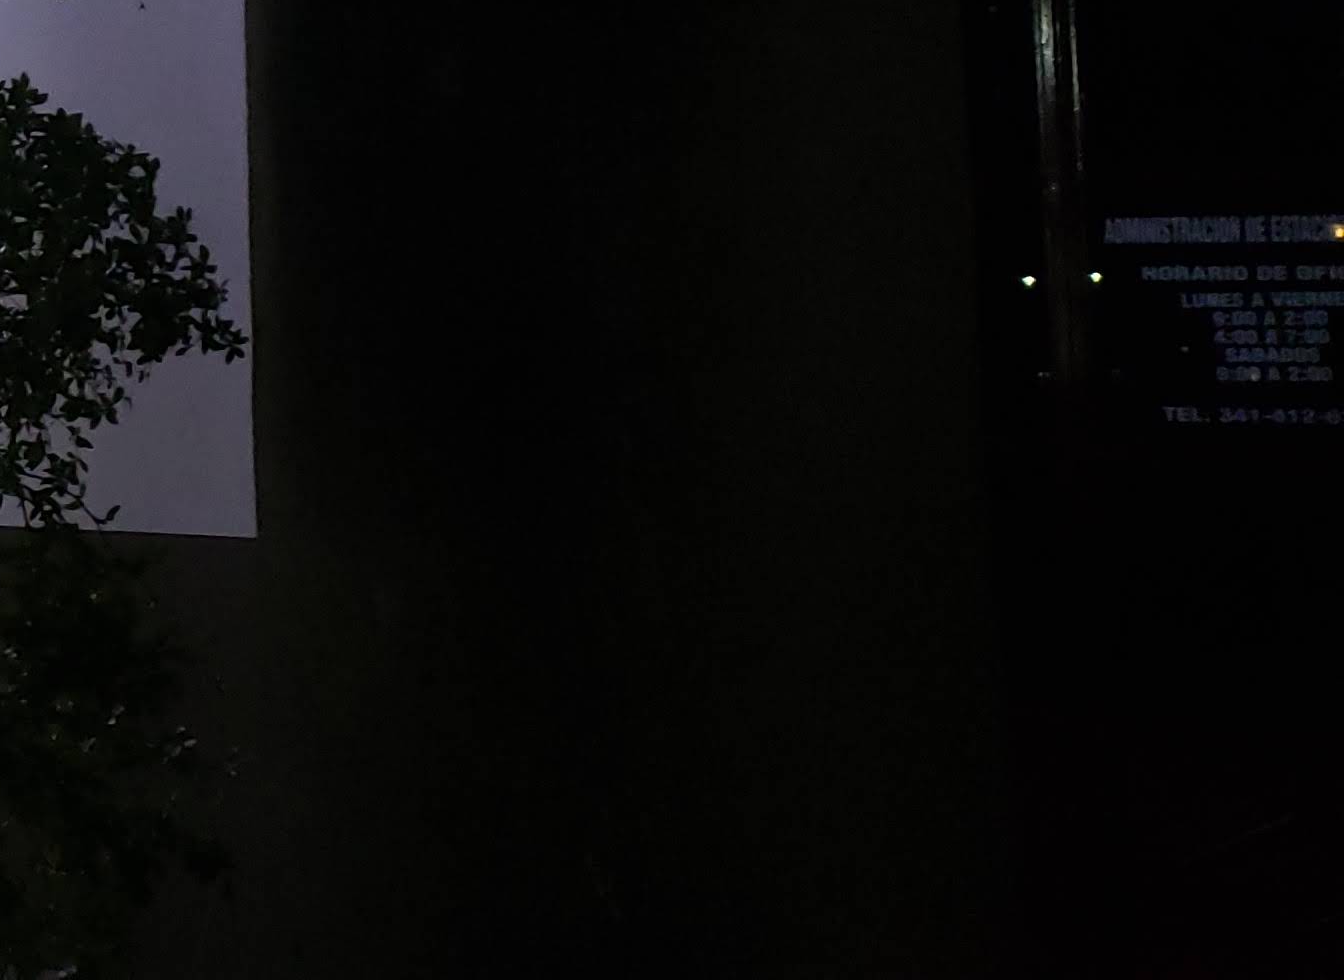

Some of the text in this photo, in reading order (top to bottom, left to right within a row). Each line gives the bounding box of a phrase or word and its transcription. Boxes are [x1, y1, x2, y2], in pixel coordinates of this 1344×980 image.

[1244, 216, 1266, 242] DE
[1140, 265, 1249, 282] HORARIO
[1257, 265, 1287, 281] DE
[1181, 292, 1244, 308] LUNES
[1251, 292, 1265, 308] A
[1263, 310, 1276, 326] A
[1265, 329, 1278, 344] A
[1225, 347, 1321, 362] SABADOS
[1268, 366, 1281, 381] A
